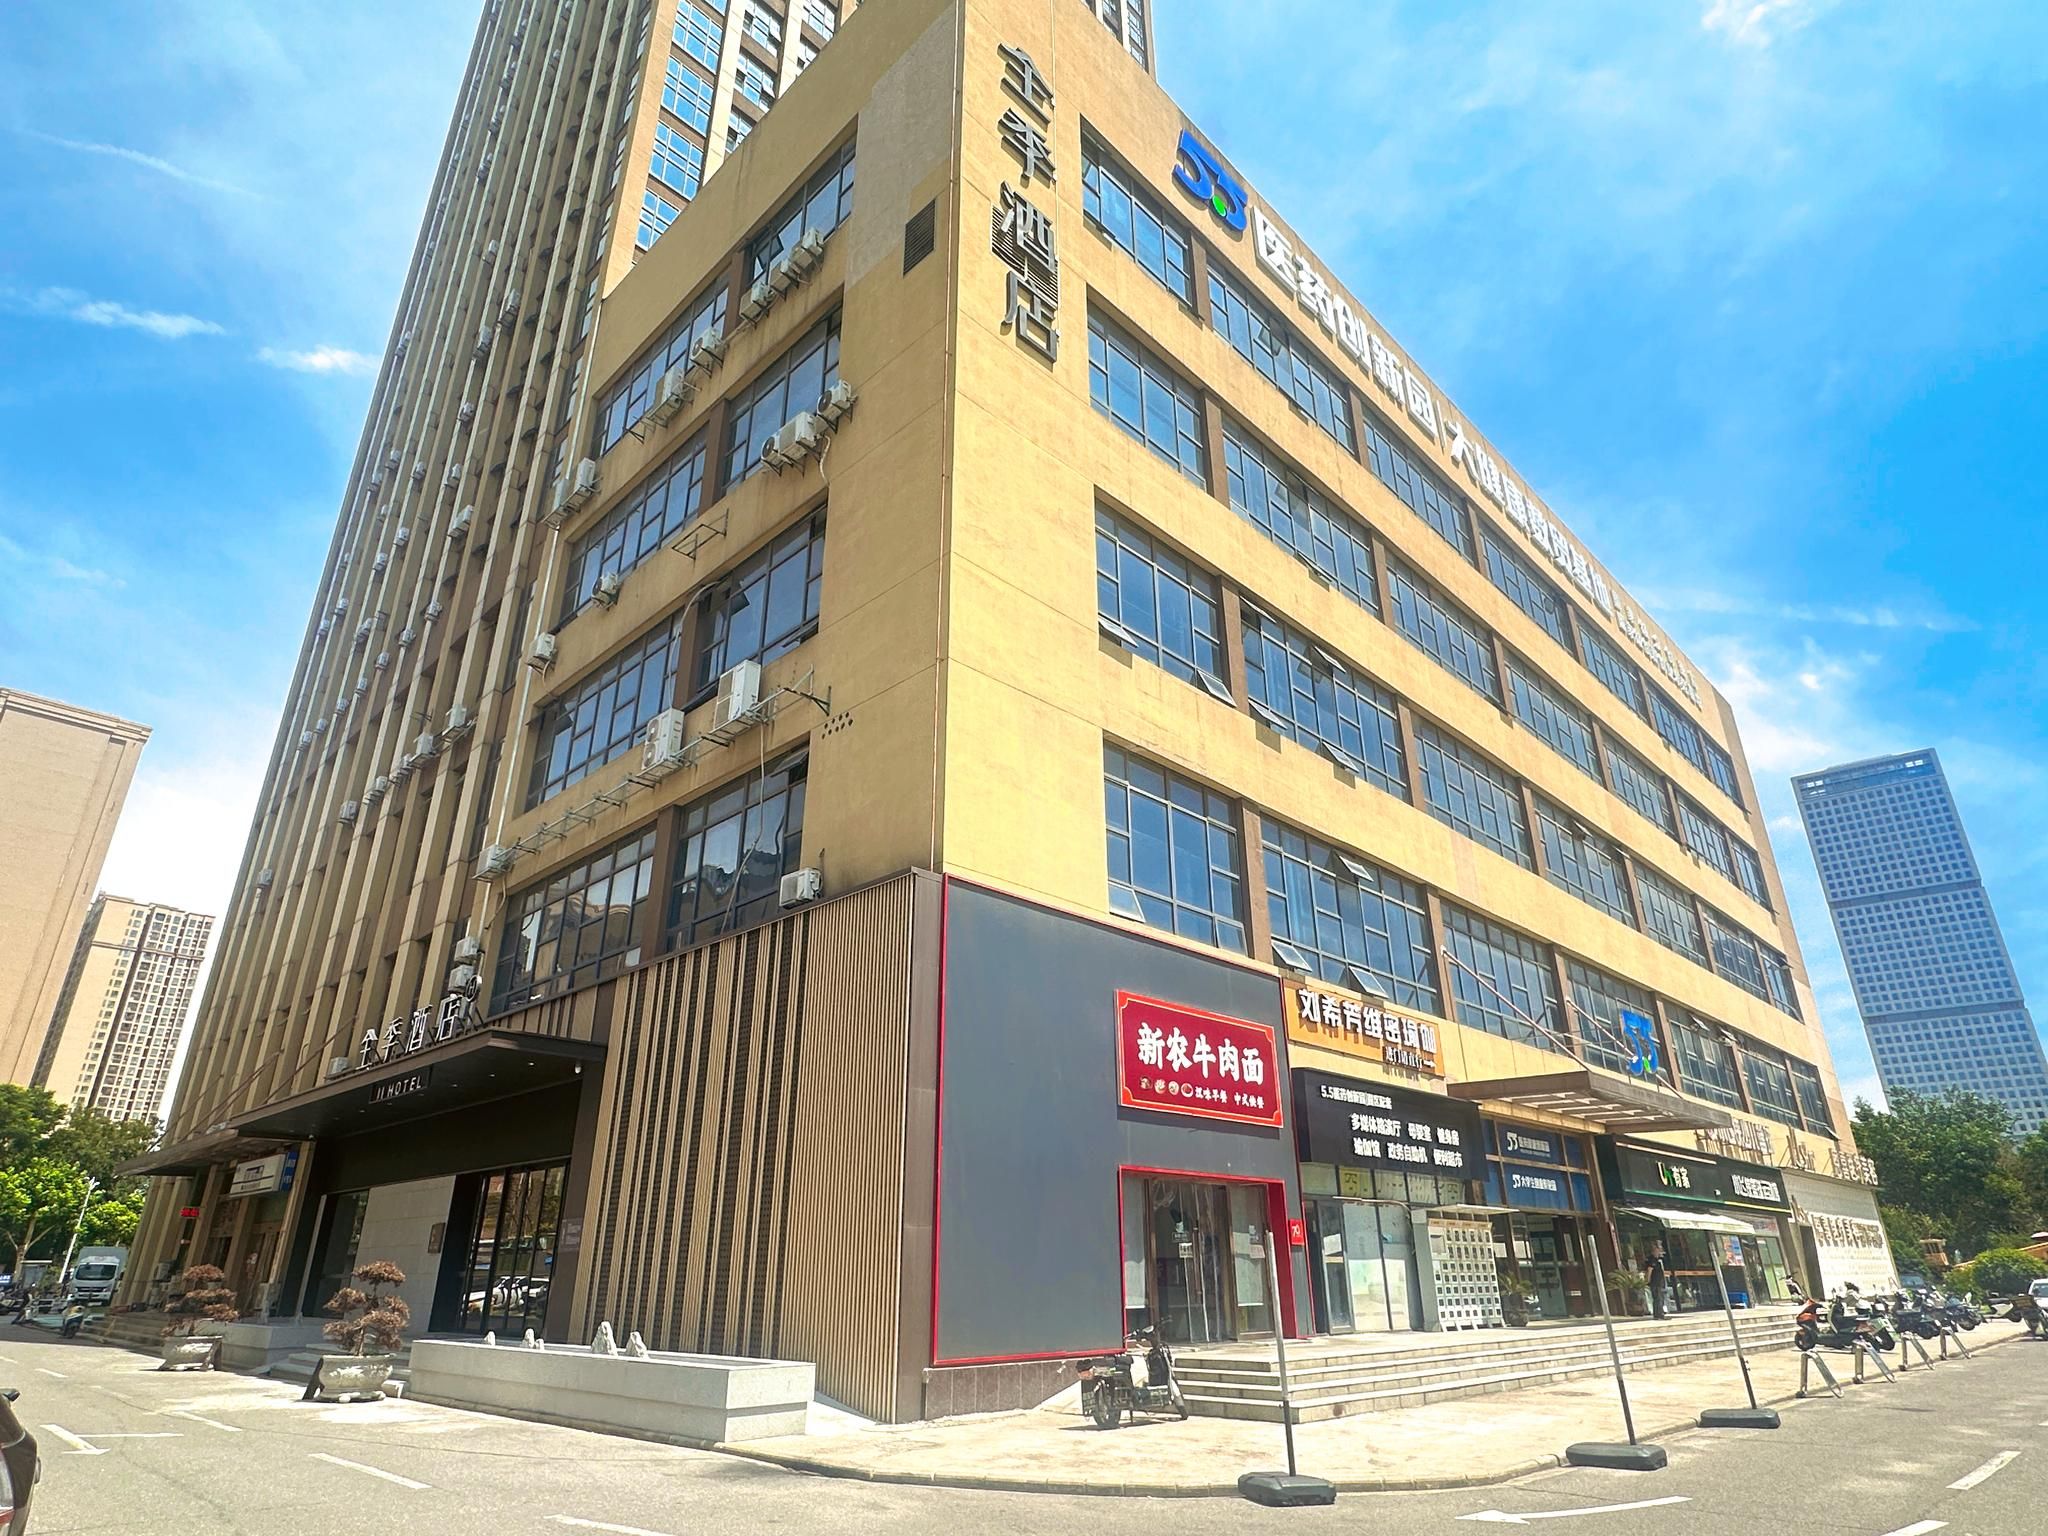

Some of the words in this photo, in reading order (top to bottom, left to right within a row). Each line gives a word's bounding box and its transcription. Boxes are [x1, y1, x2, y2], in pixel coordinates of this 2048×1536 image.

[996, 42, 1057, 364] 全季酒店
[356, 994, 463, 1070] 全季酒店
[1136, 1022, 1264, 1085] 新农牛肉面
[387, 1076, 422, 1098] HOTEL
